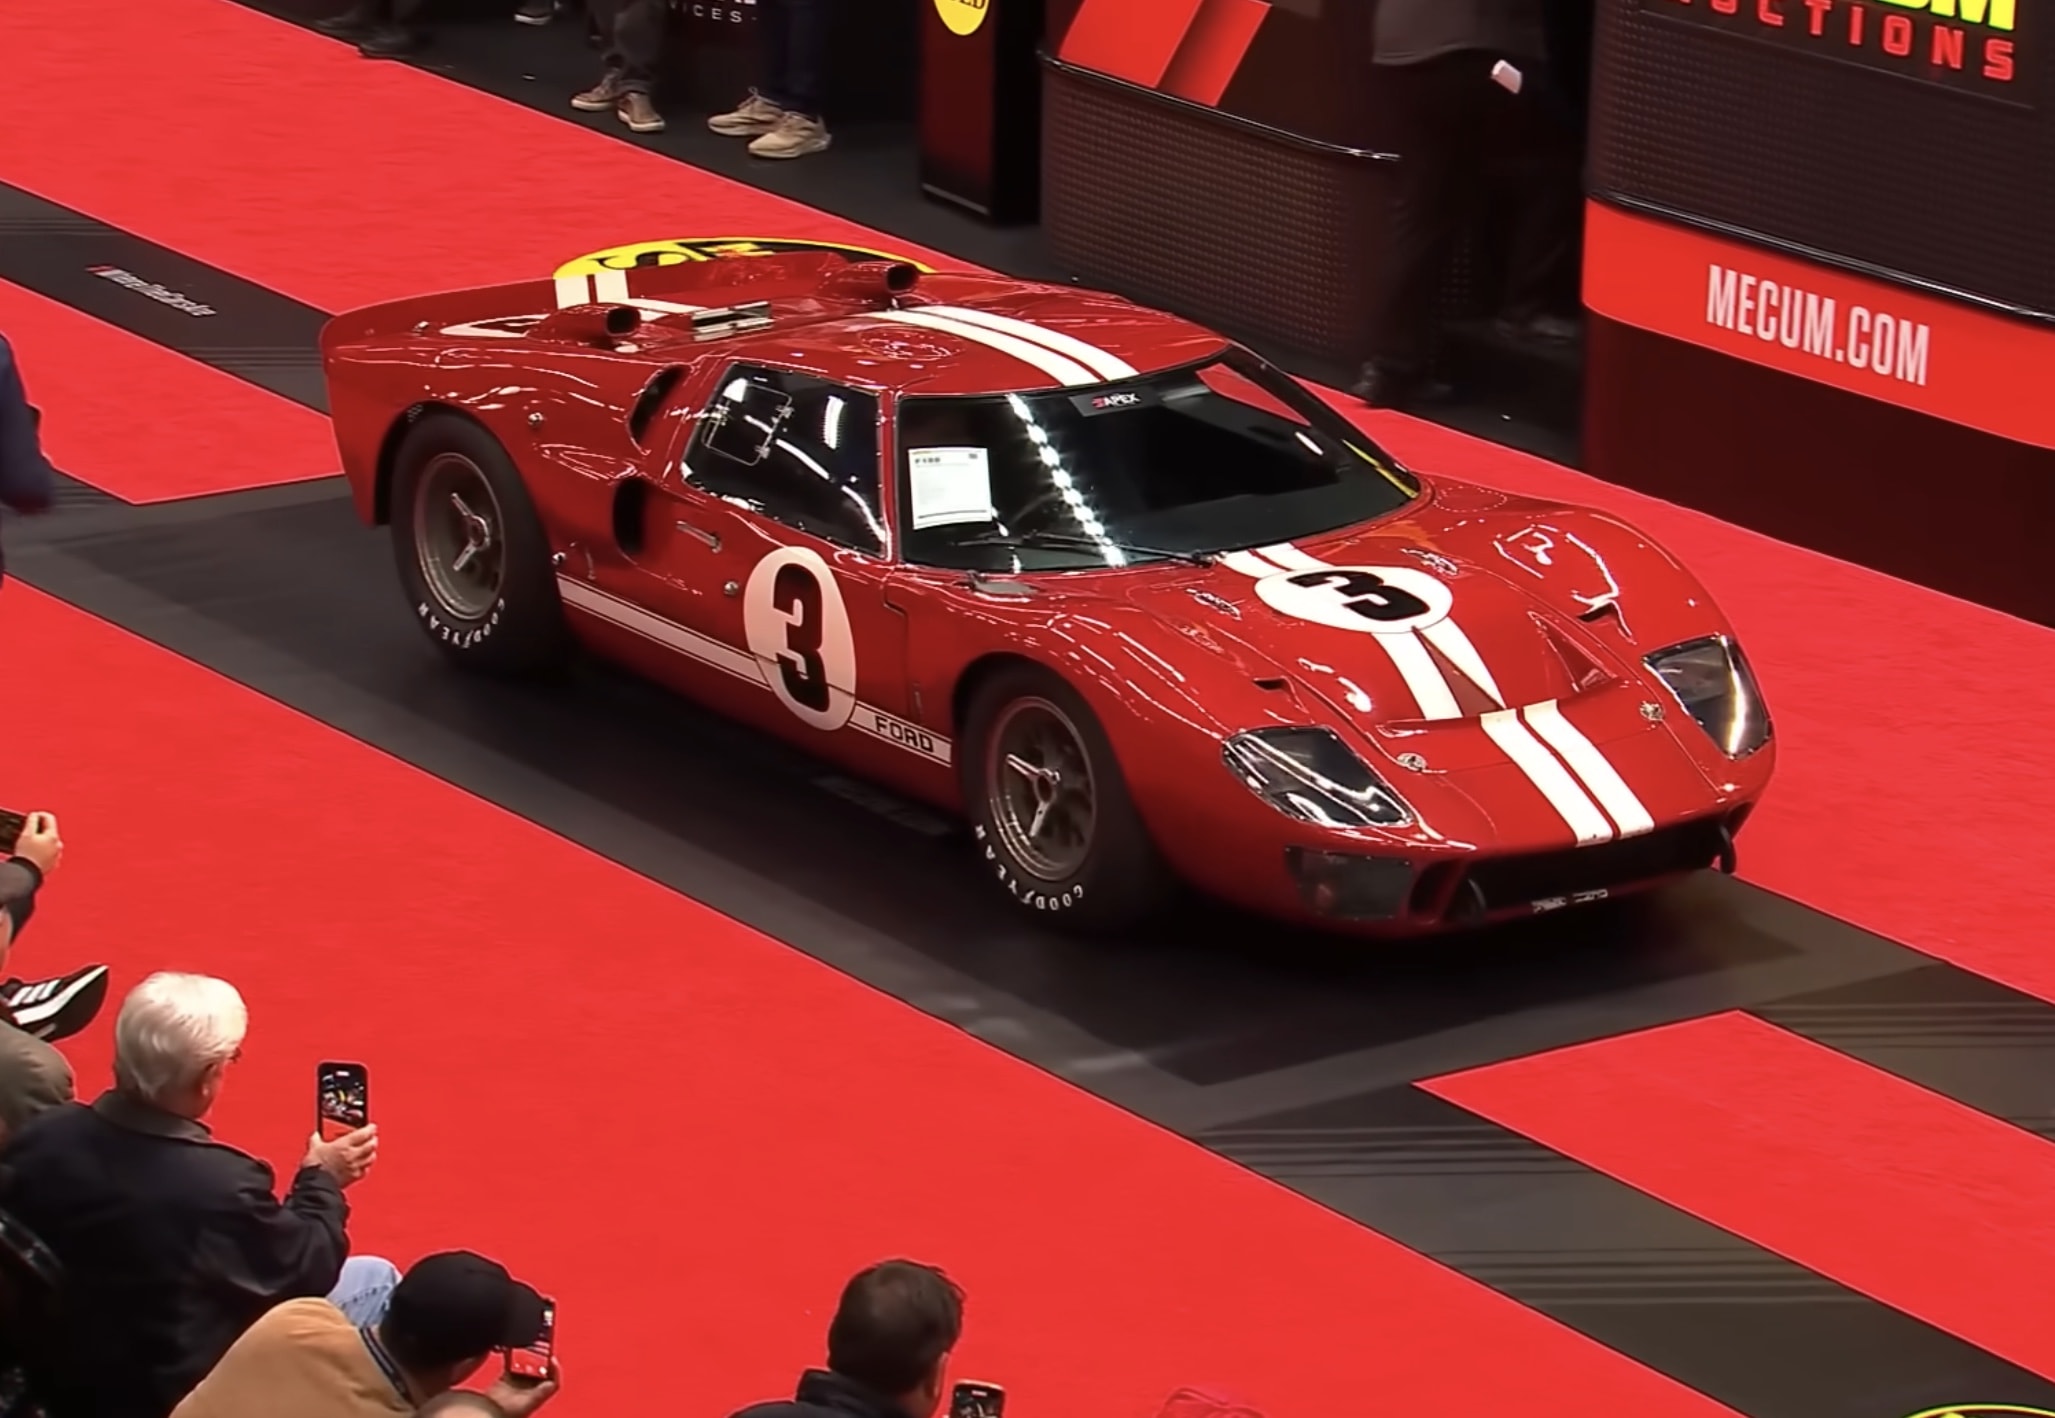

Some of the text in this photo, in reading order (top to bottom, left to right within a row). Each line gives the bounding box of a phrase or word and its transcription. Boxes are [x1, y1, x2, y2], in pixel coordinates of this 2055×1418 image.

[1676, 0, 2015, 81] CTIONS
[1706, 264, 1930, 386] MECUM.COM
[418, 598, 506, 649] GOODYEAR
[1286, 571, 1431, 621] 3
[773, 562, 830, 713] 3
[874, 714, 934, 753] FORD
[975, 824, 1084, 911] GOODYEAR
